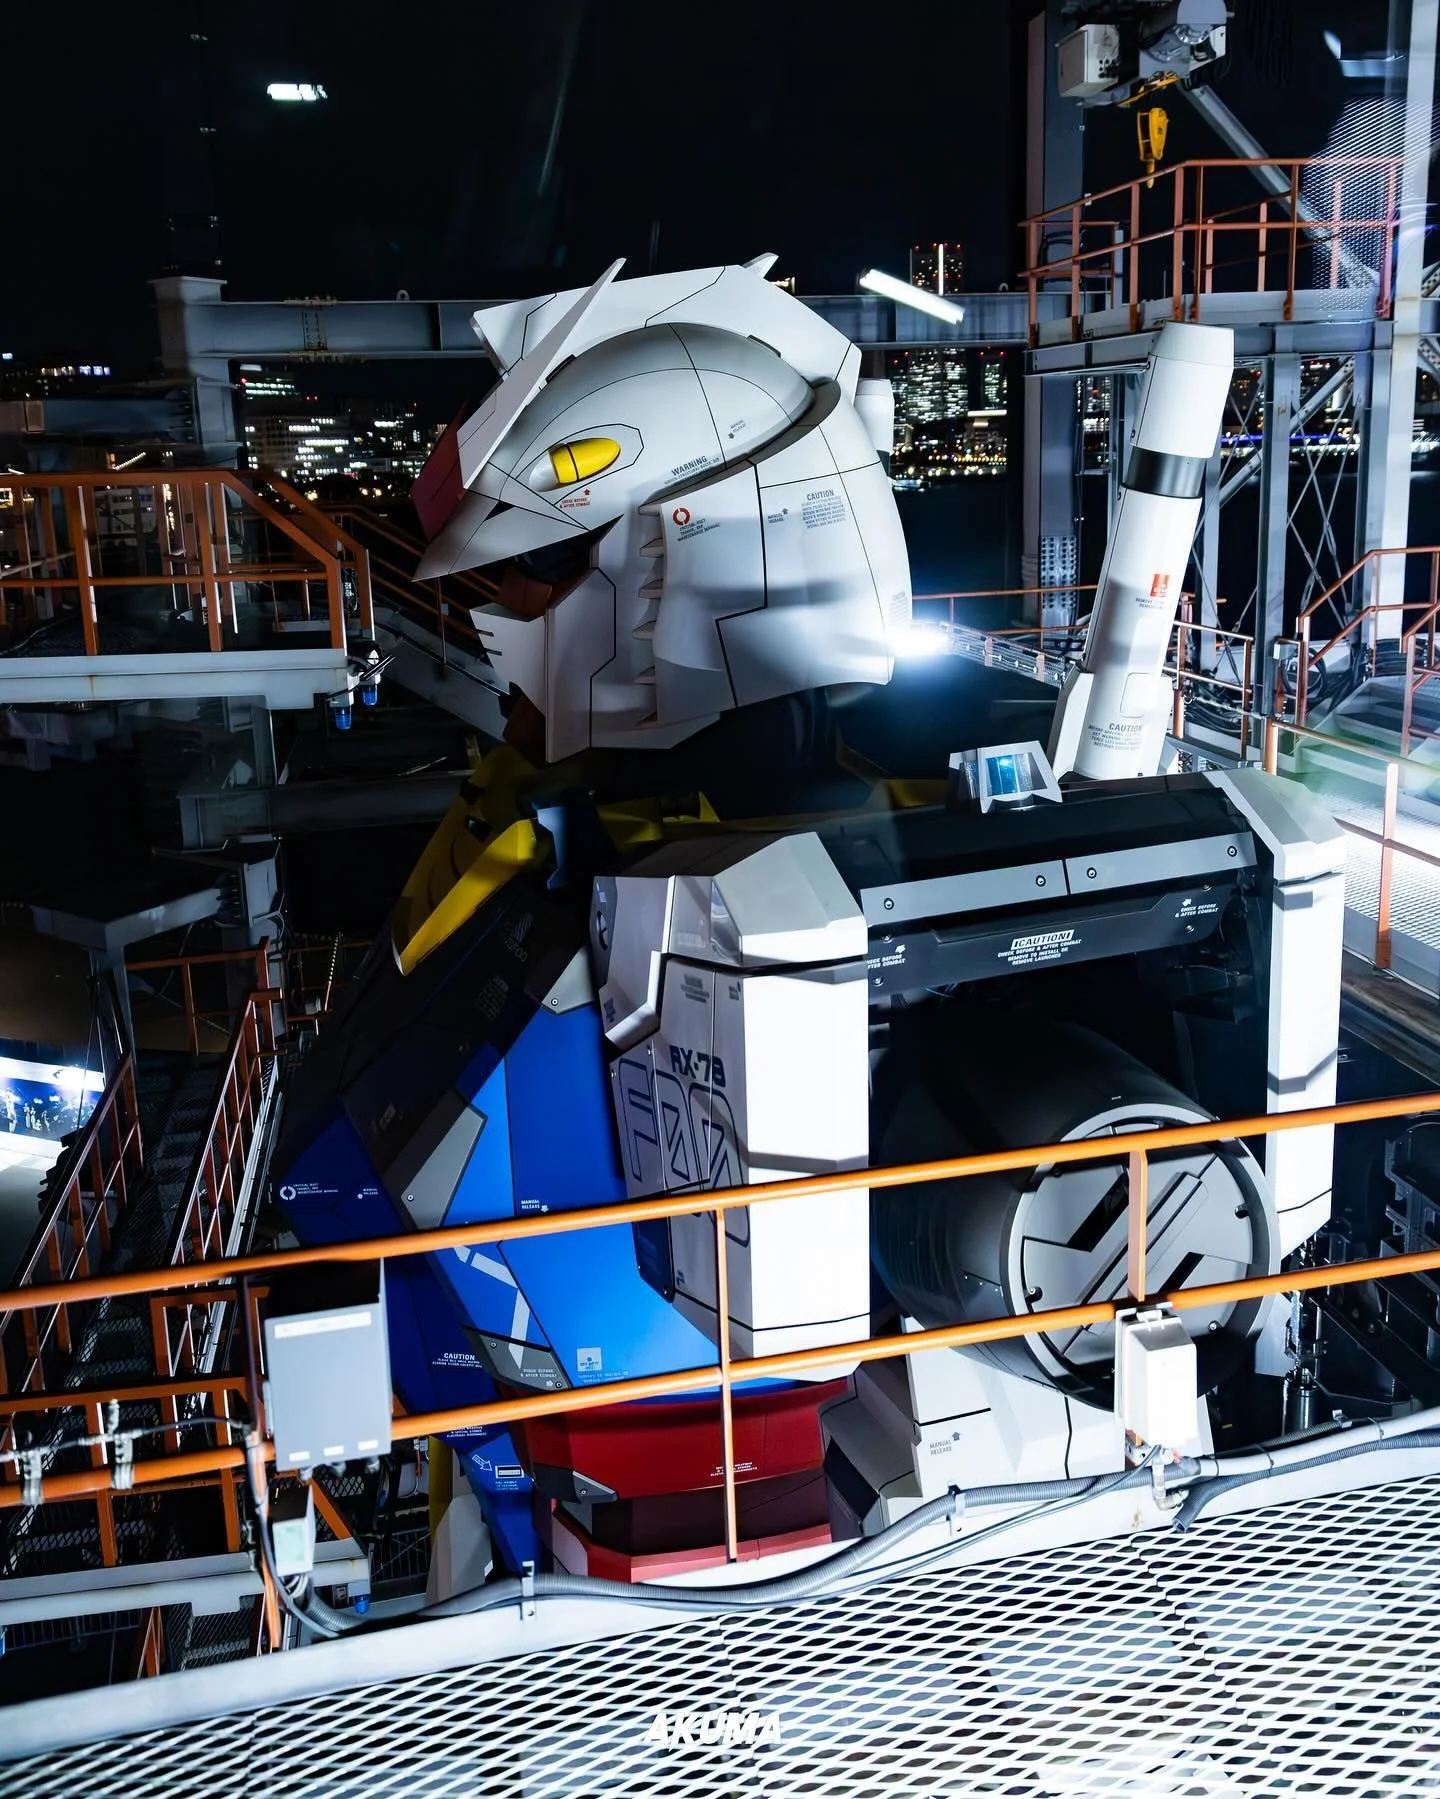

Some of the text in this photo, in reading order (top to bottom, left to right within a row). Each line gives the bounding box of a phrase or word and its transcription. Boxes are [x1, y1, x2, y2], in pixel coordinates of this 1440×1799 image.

[671, 456, 707, 476] WARNING
[807, 490, 835, 501] CAUTION
[882, 954, 903, 962] BEFORE
[882, 958, 905, 967] COMBAT
[669, 1045, 726, 1088] RX-78
[443, 1353, 475, 1361] CAUTION
[930, 1440, 952, 1449] MANUAL
[930, 1446, 953, 1456] RELEASE
